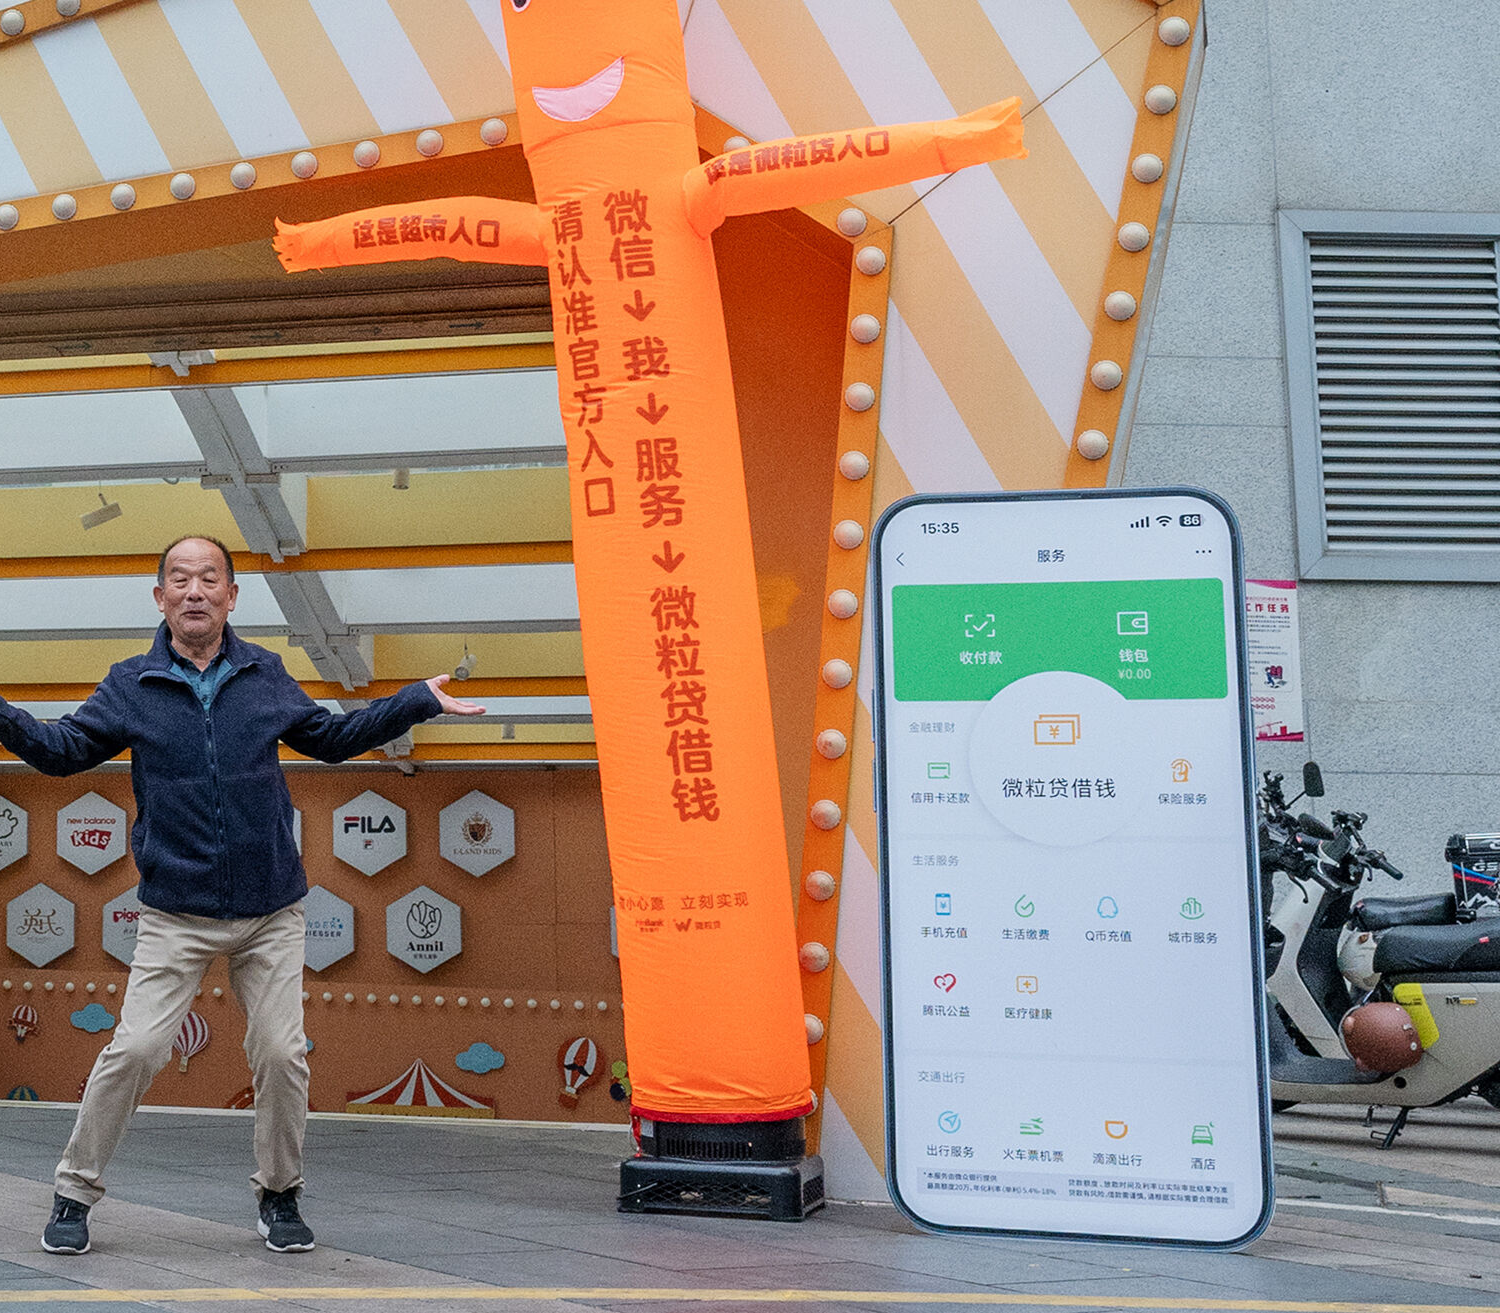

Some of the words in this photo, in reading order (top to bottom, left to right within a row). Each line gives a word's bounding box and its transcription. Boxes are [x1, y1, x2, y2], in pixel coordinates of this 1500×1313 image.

[603, 189, 656, 282] 微信
[552, 200, 616, 517] 请认准官方入口
[622, 336, 670, 381] 我
[636, 437, 686, 529] 服务
[920, 522, 960, 535] 15:35
[1183, 515, 1200, 526] 86
[1037, 549, 1066, 563] 服务
[959, 650, 1003, 665] 收付款
[1118, 648, 1149, 663] 钱包
[1117, 668, 1151, 680] ¥0.00
[650, 585, 721, 823] 微粒贷借钱
[908, 721, 956, 734] 金融理财
[1001, 777, 1117, 799] 微粒贷借钱
[910, 791, 971, 805] 信用卡还款
[1157, 792, 1208, 806] 保险服务
[83, 816, 116, 825] balance
[344, 816, 396, 834] FILA
[73, 830, 109, 847] Kids
[912, 855, 960, 867] 生活服务
[681, 892, 750, 910] 立刻实现
[112, 908, 142, 922] pige
[920, 926, 969, 940] 手机充值
[1001, 927, 1050, 942] 生活缴费
[1084, 929, 1133, 944] Q币充值
[1167, 931, 1219, 945] 城市服务
[404, 940, 444, 952] Annil
[922, 1004, 971, 1019] 腾讯公益
[1004, 1007, 1053, 1021] 医疗健康
[917, 1070, 966, 1084] 交通出行
[926, 1145, 975, 1160] 出行服务
[1002, 1148, 1064, 1163] 火车票机票
[1092, 1152, 1143, 1167] 滴滴出行
[1190, 1157, 1216, 1171] 酒店
